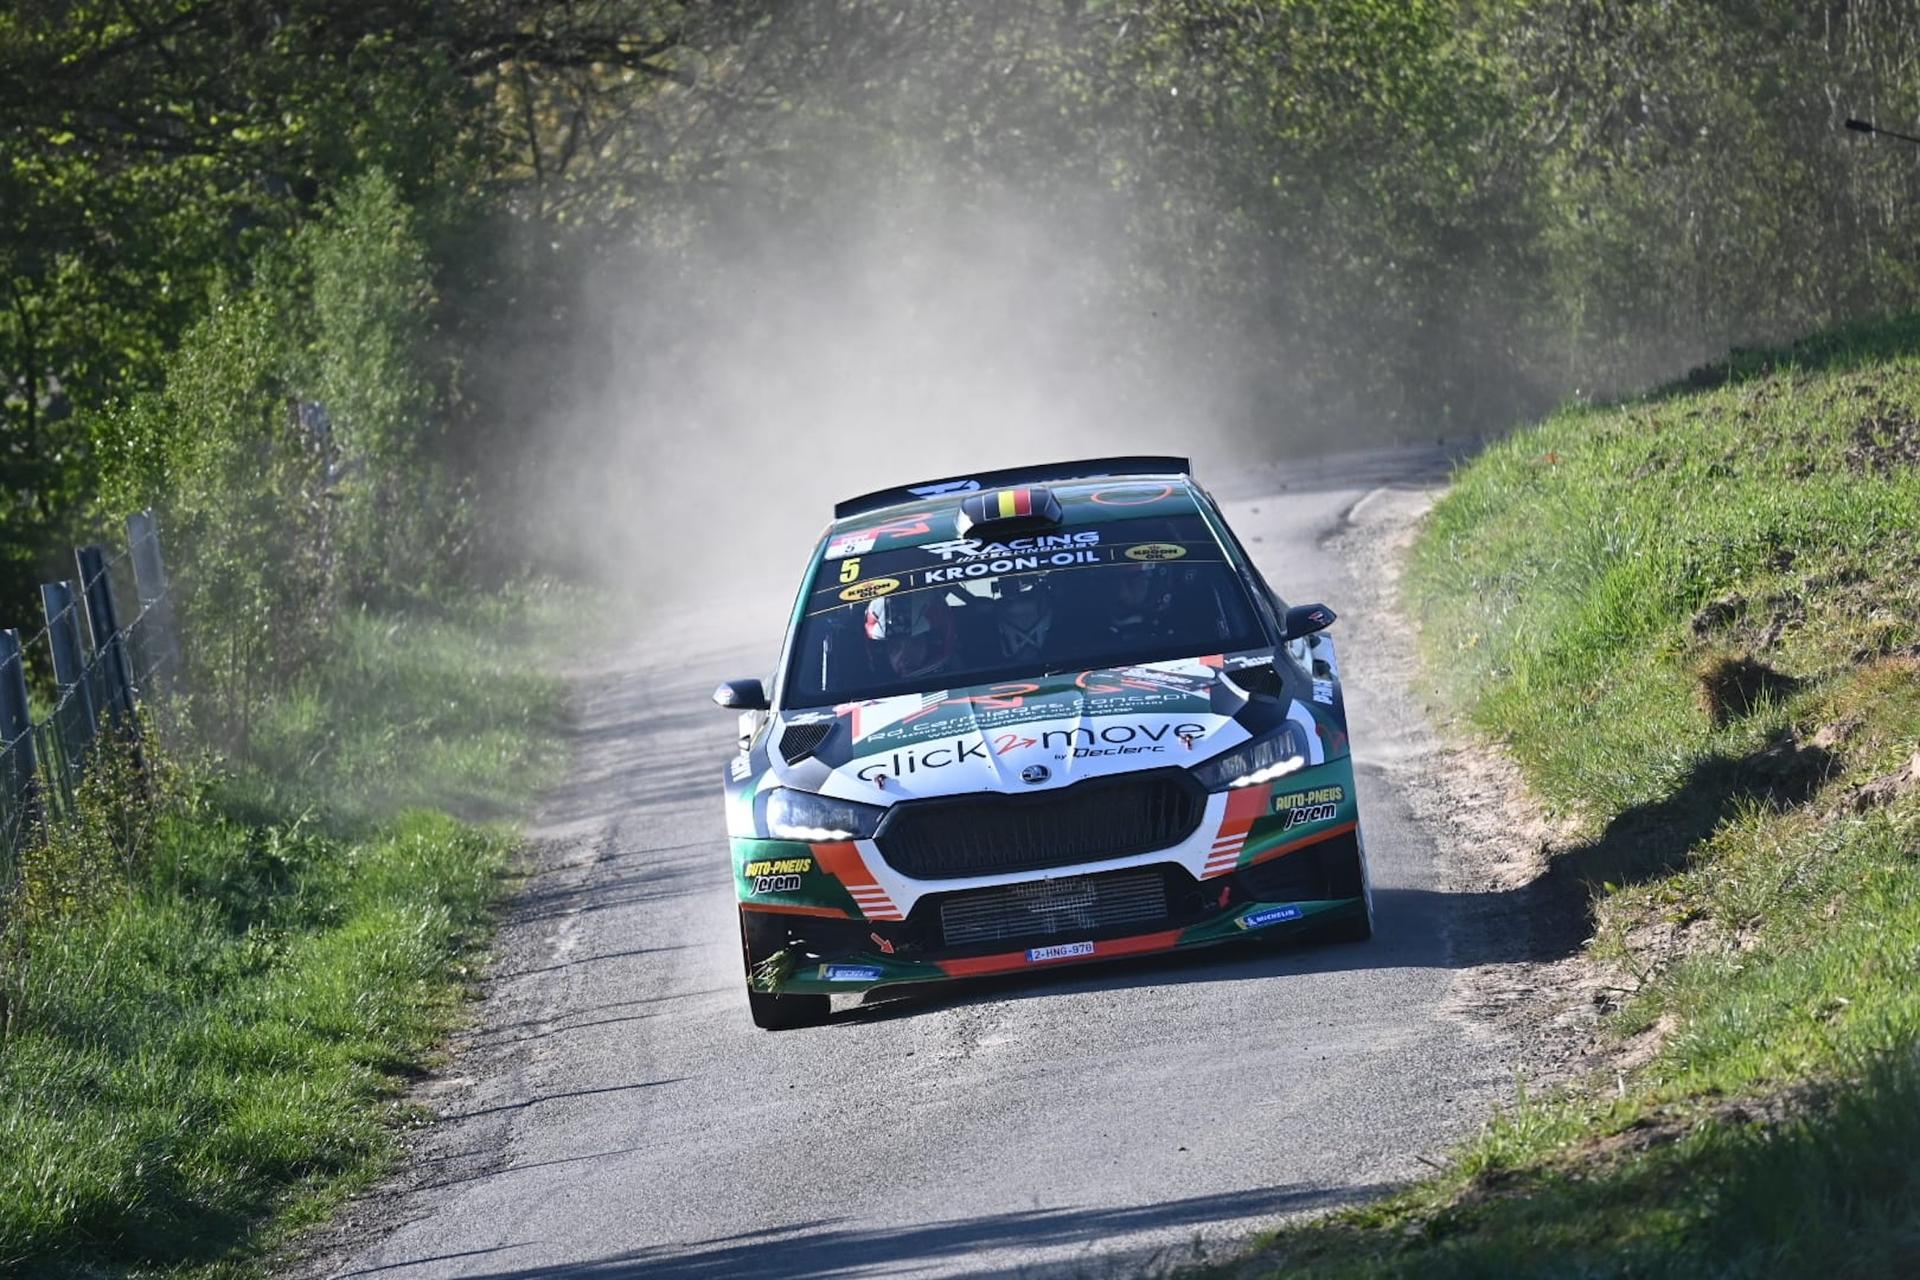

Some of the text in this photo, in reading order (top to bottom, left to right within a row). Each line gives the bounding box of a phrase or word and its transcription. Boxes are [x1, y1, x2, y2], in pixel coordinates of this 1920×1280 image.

[839, 557, 861, 583] 5
[925, 550, 1100, 584] KROON-OIL
[847, 582, 891, 597] KROON
[1073, 745, 1165, 758] Declerc
[1275, 786, 1342, 811] AUTO-PNEUS
[745, 858, 811, 877] AUTO-PNEUS
[1256, 909, 1295, 922] MICHELIN
